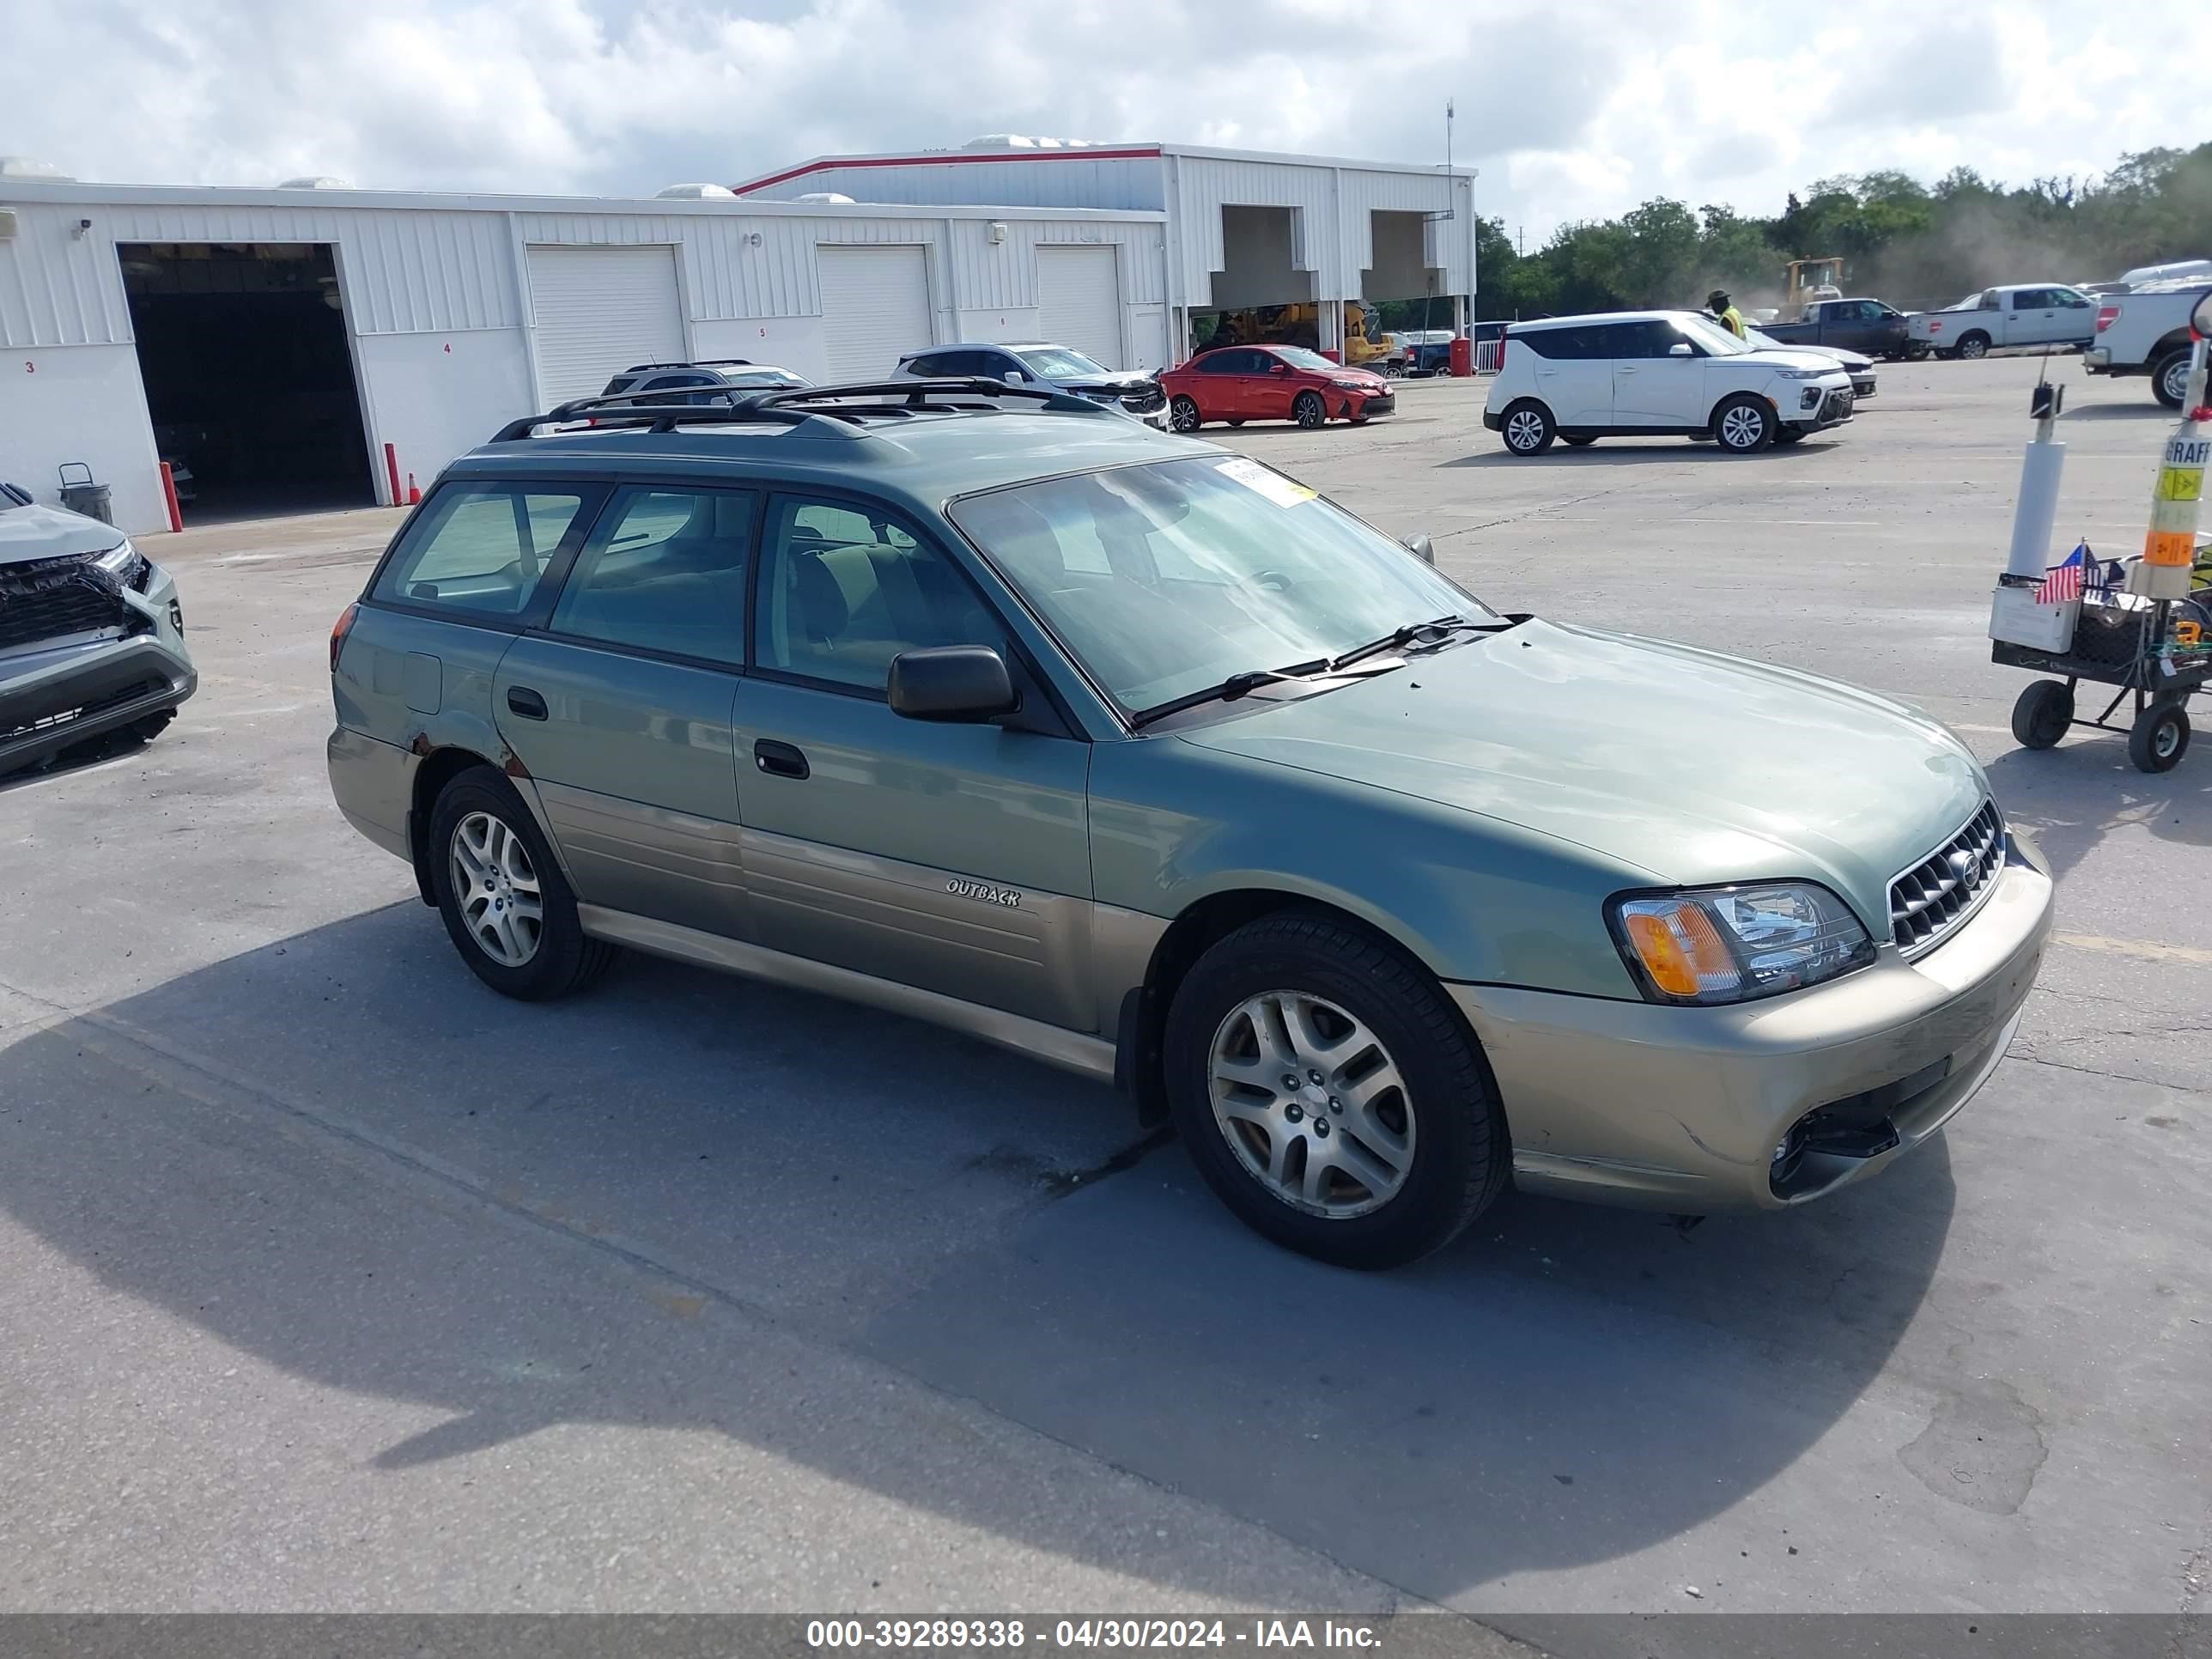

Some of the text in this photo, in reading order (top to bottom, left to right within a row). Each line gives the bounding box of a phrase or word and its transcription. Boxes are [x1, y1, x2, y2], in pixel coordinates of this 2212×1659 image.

[759, 327, 766, 337] 5
[443, 343, 452, 354] 4
[25, 361, 35, 374] 3
[945, 878, 1022, 907] OUTBACK
